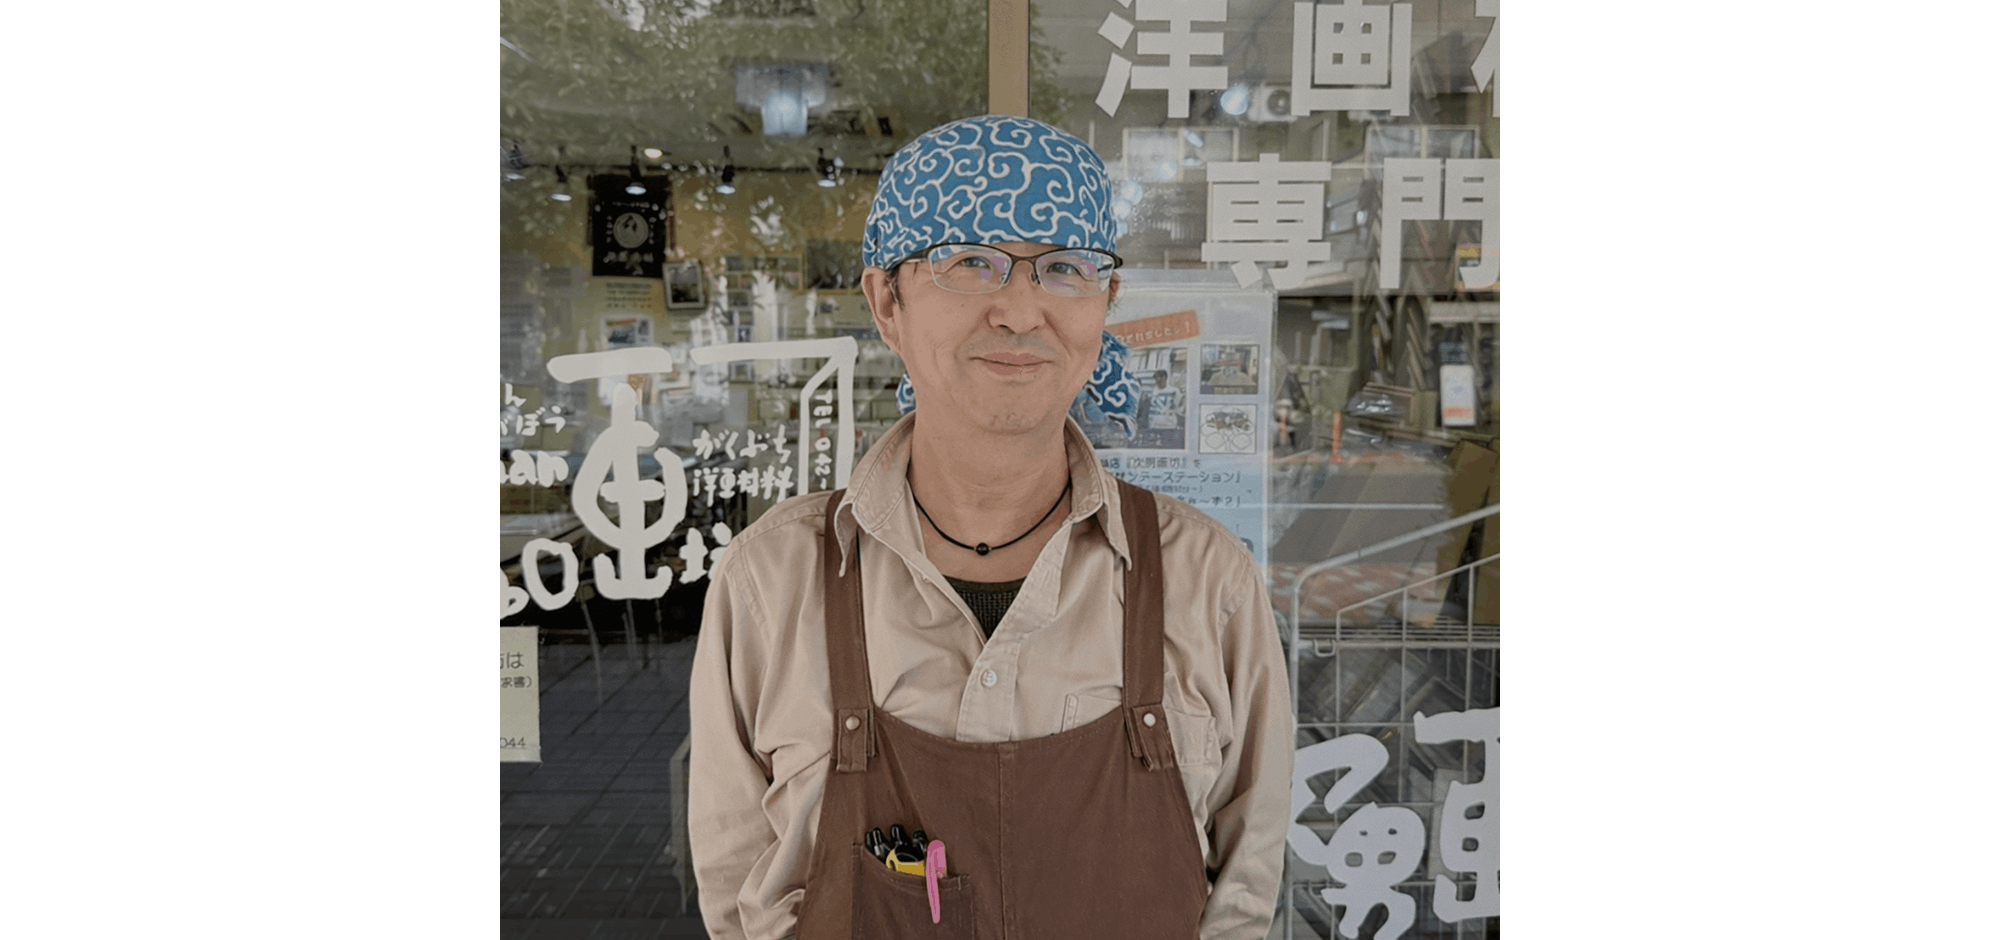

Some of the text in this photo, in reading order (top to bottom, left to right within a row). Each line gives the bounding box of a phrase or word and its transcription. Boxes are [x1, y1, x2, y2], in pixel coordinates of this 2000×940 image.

[813, 389, 833, 428] TEL
[691, 423, 792, 464] がくぶち
